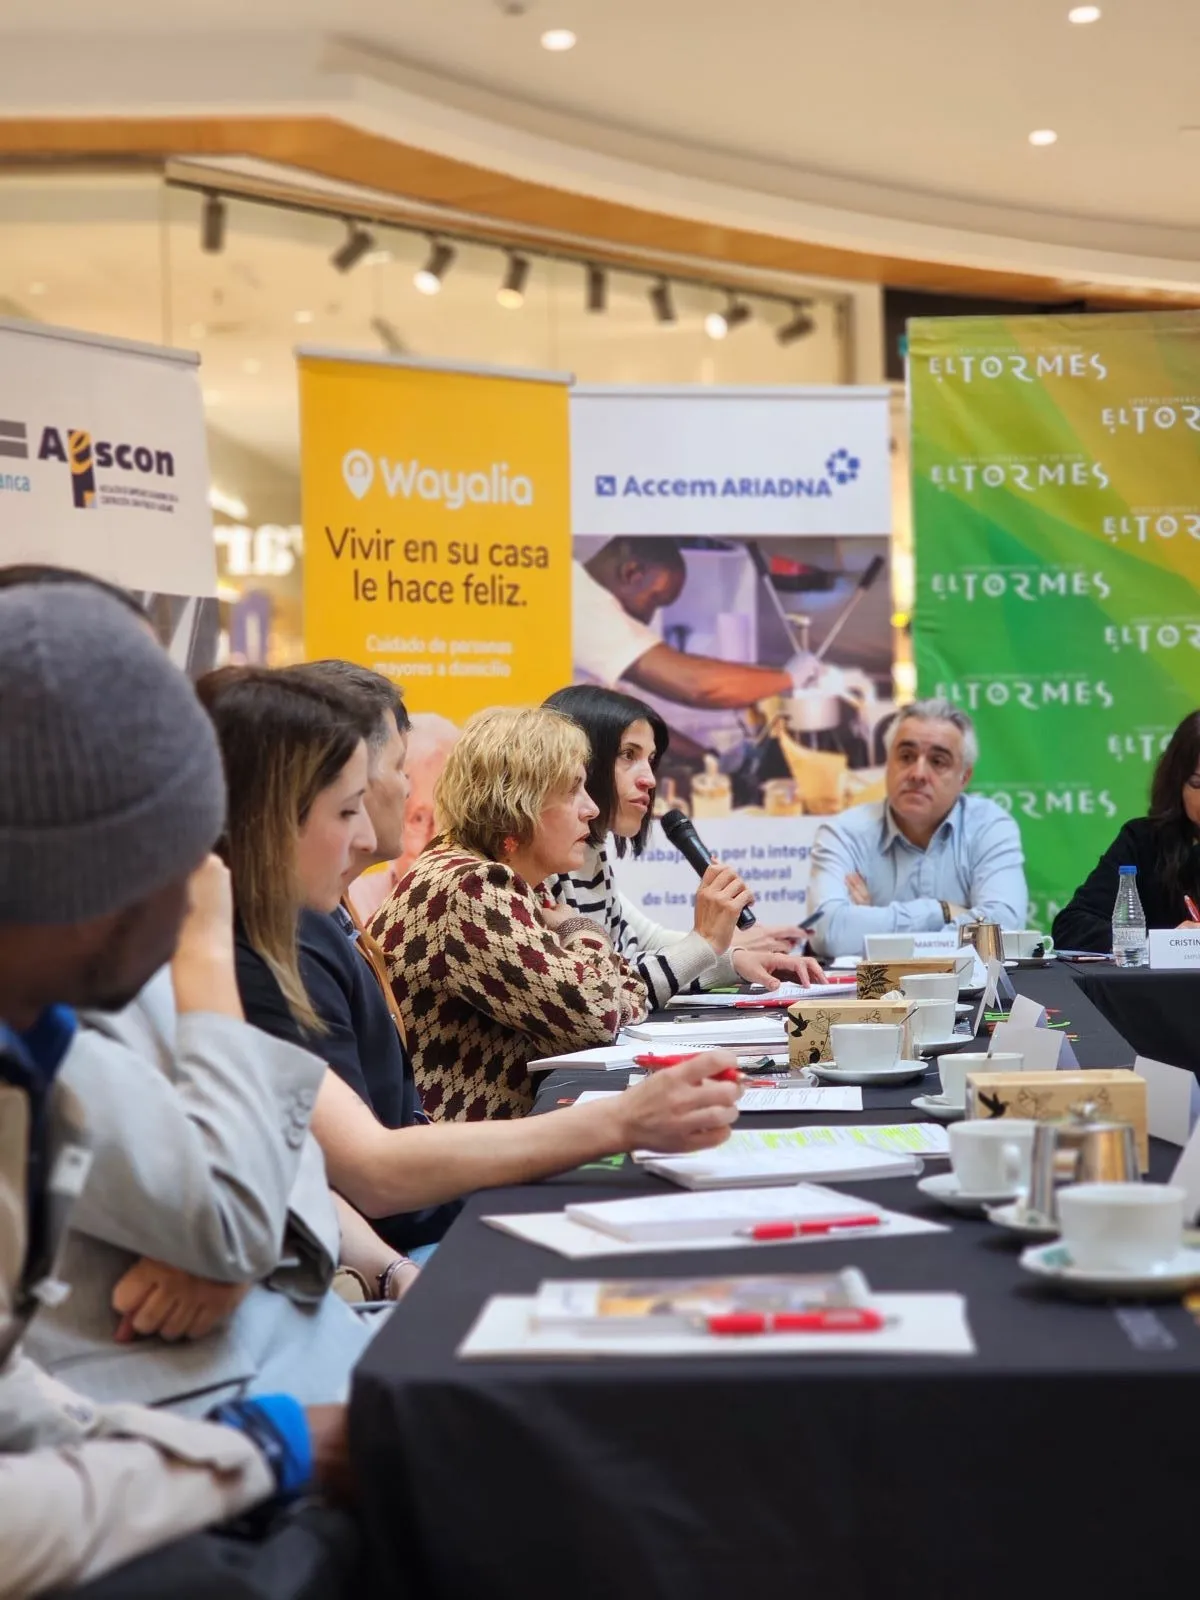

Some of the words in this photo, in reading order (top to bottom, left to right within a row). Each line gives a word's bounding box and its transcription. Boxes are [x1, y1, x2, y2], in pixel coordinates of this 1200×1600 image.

[379, 457, 534, 510] Wayalia
[623, 476, 717, 497] Accem
[721, 478, 832, 498] ARIADNA
[325, 526, 396, 562] Vivir
[403, 538, 438, 564] en
[447, 540, 479, 566] su
[488, 543, 549, 569] casa
[353, 569, 377, 602] le
[388, 570, 454, 605] hace
[462, 573, 527, 607] feliz.
[366, 634, 425, 653] Cuidado
[428, 637, 447, 653] de
